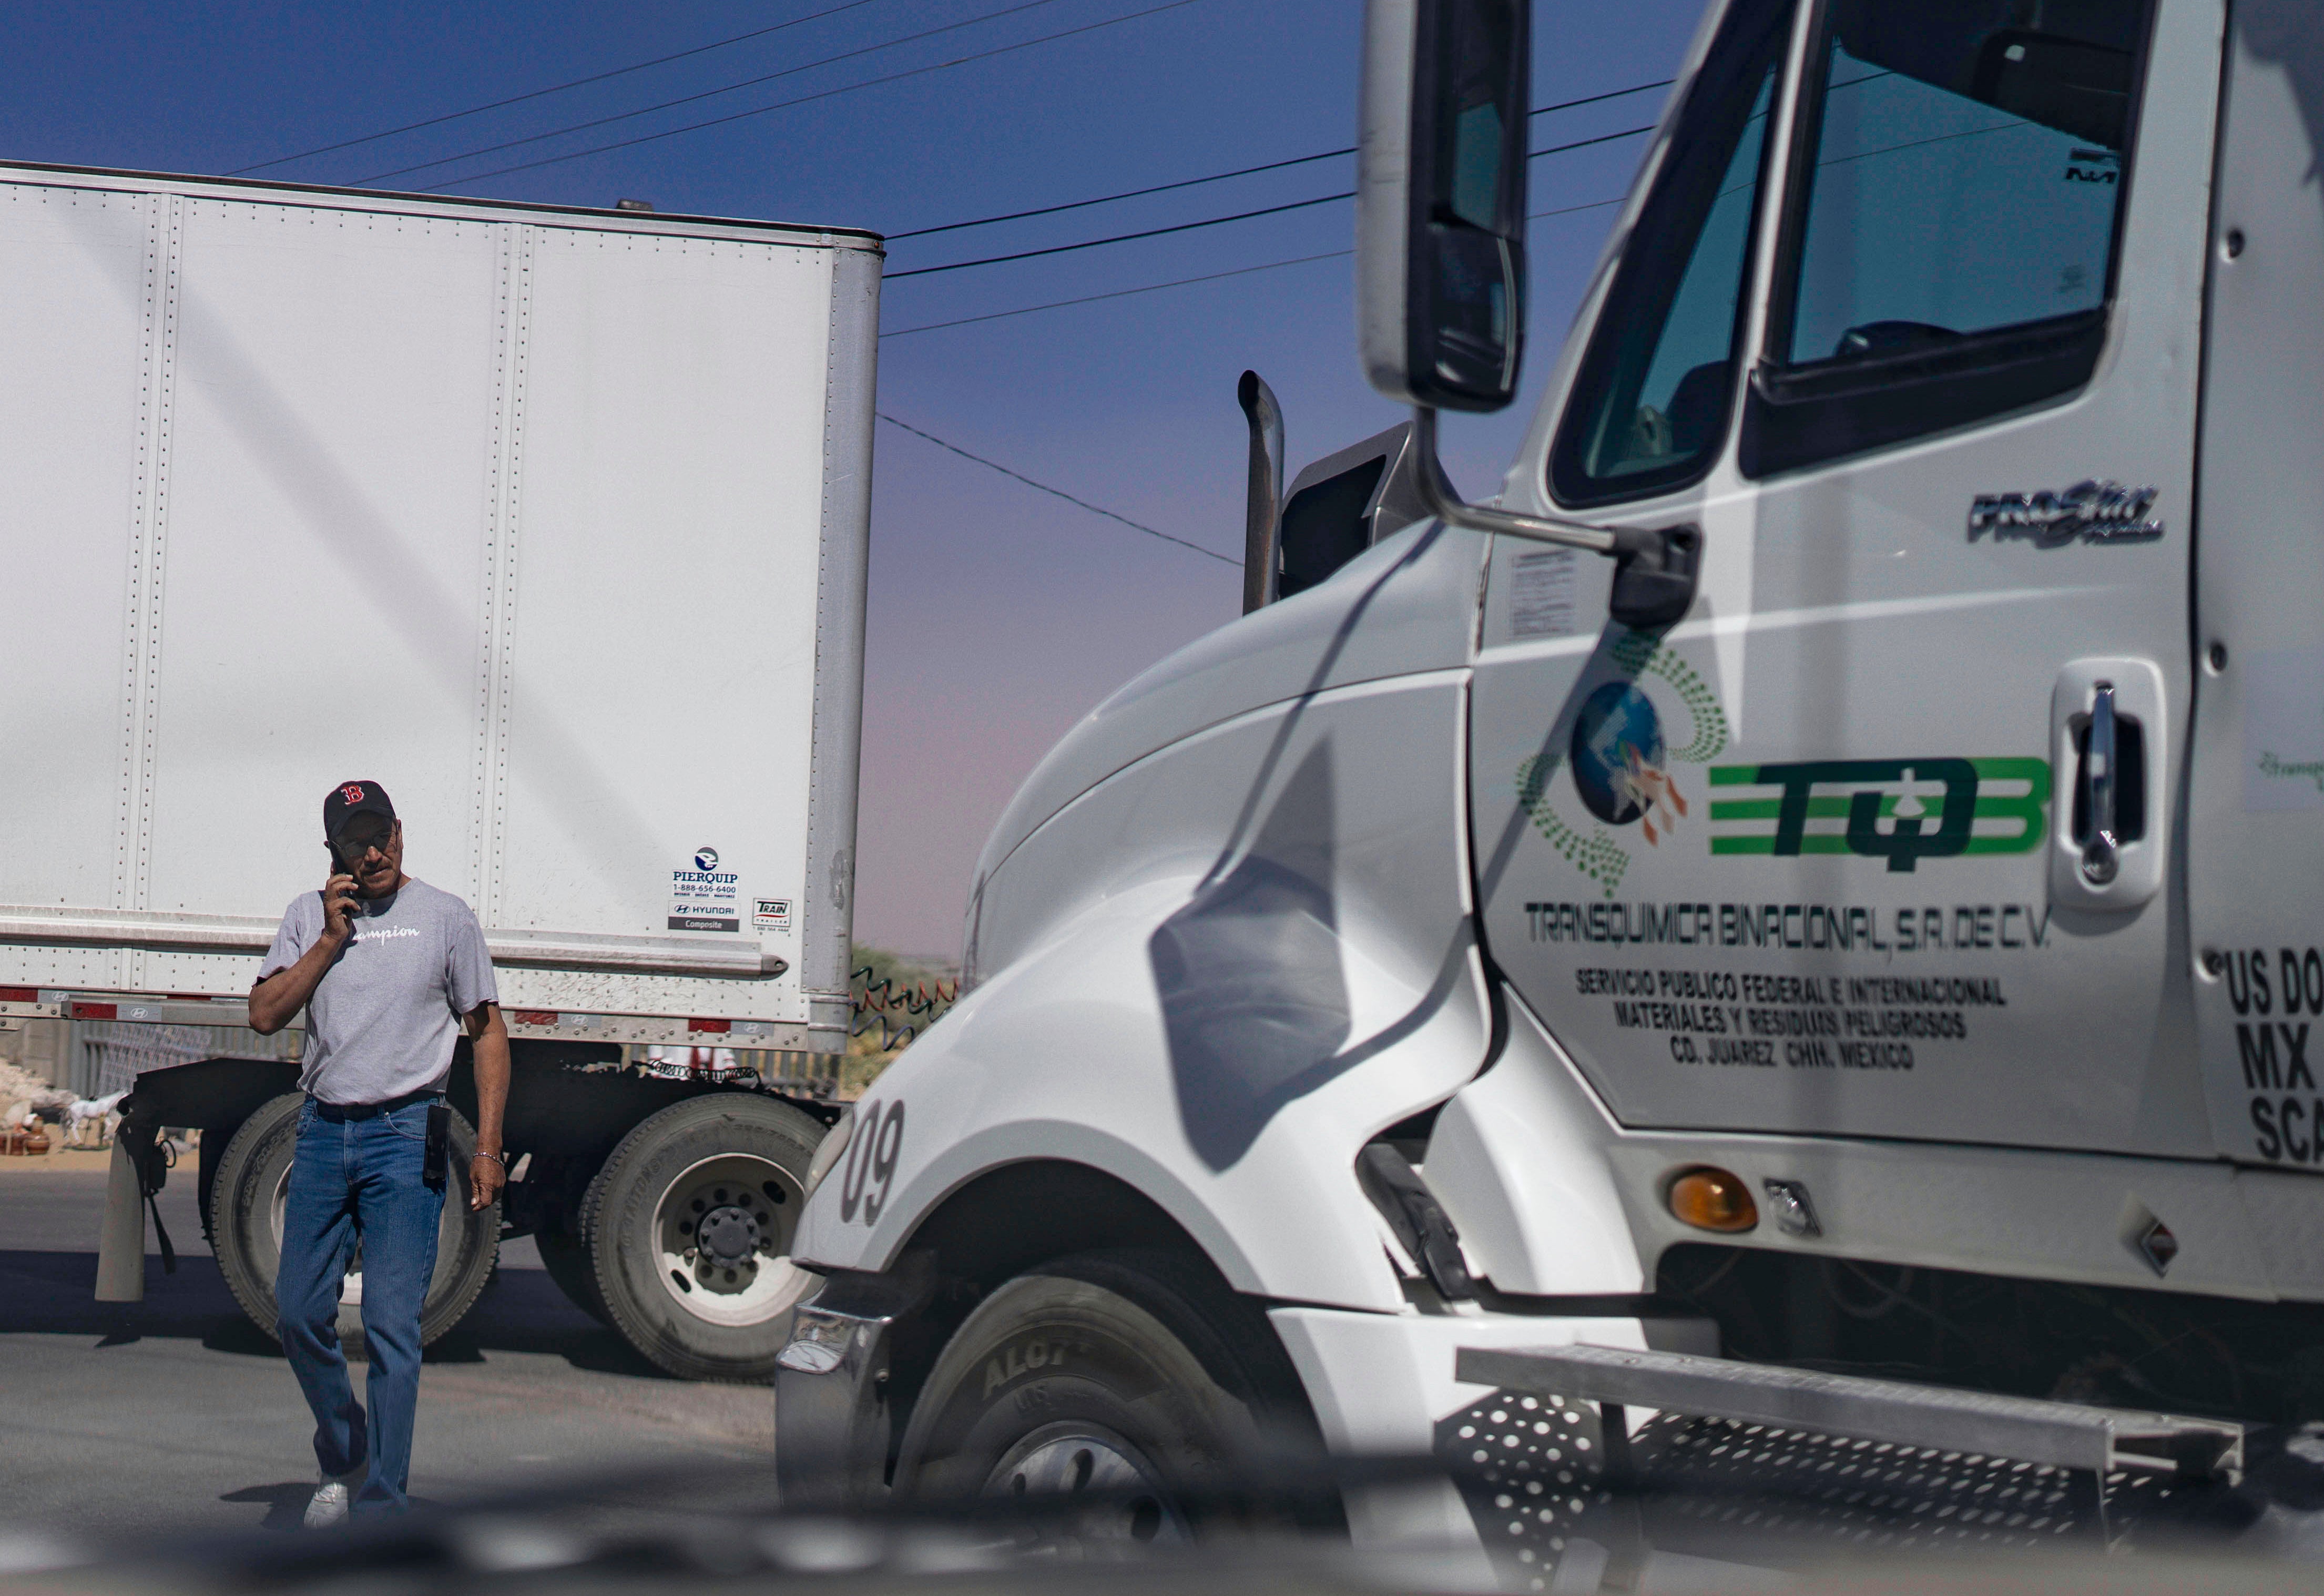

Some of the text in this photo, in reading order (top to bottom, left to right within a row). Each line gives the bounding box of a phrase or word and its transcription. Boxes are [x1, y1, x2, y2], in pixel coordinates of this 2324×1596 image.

[341, 785, 364, 805] B
[672, 871, 738, 885] PIERQUIP
[674, 883, 737, 893] 1-888-656-6400
[692, 906, 735, 914] HYUNDAI
[757, 901, 788, 914] TRAIN
[352, 925, 420, 946] ampion
[685, 919, 723, 929] Composite
[1525, 902, 1714, 949] TRANSQUIMICA
[1954, 907, 1995, 949] DE
[1576, 968, 2007, 1007] SERVICIO PUBLICO FEDERAL E INTERNACIONAL
[2224, 949, 2272, 1016] US
[1613, 1001, 1728, 1034] MATERIALES
[1727, 1007, 1744, 1035] Y
[1844, 1010, 1967, 1039] PELIGROSOS
[1707, 1036, 1778, 1067] JUAREZ
[1839, 1041, 1914, 1070] MEXICO
[2235, 1022, 2316, 1089] MX
[841, 1099, 905, 1227] 09
